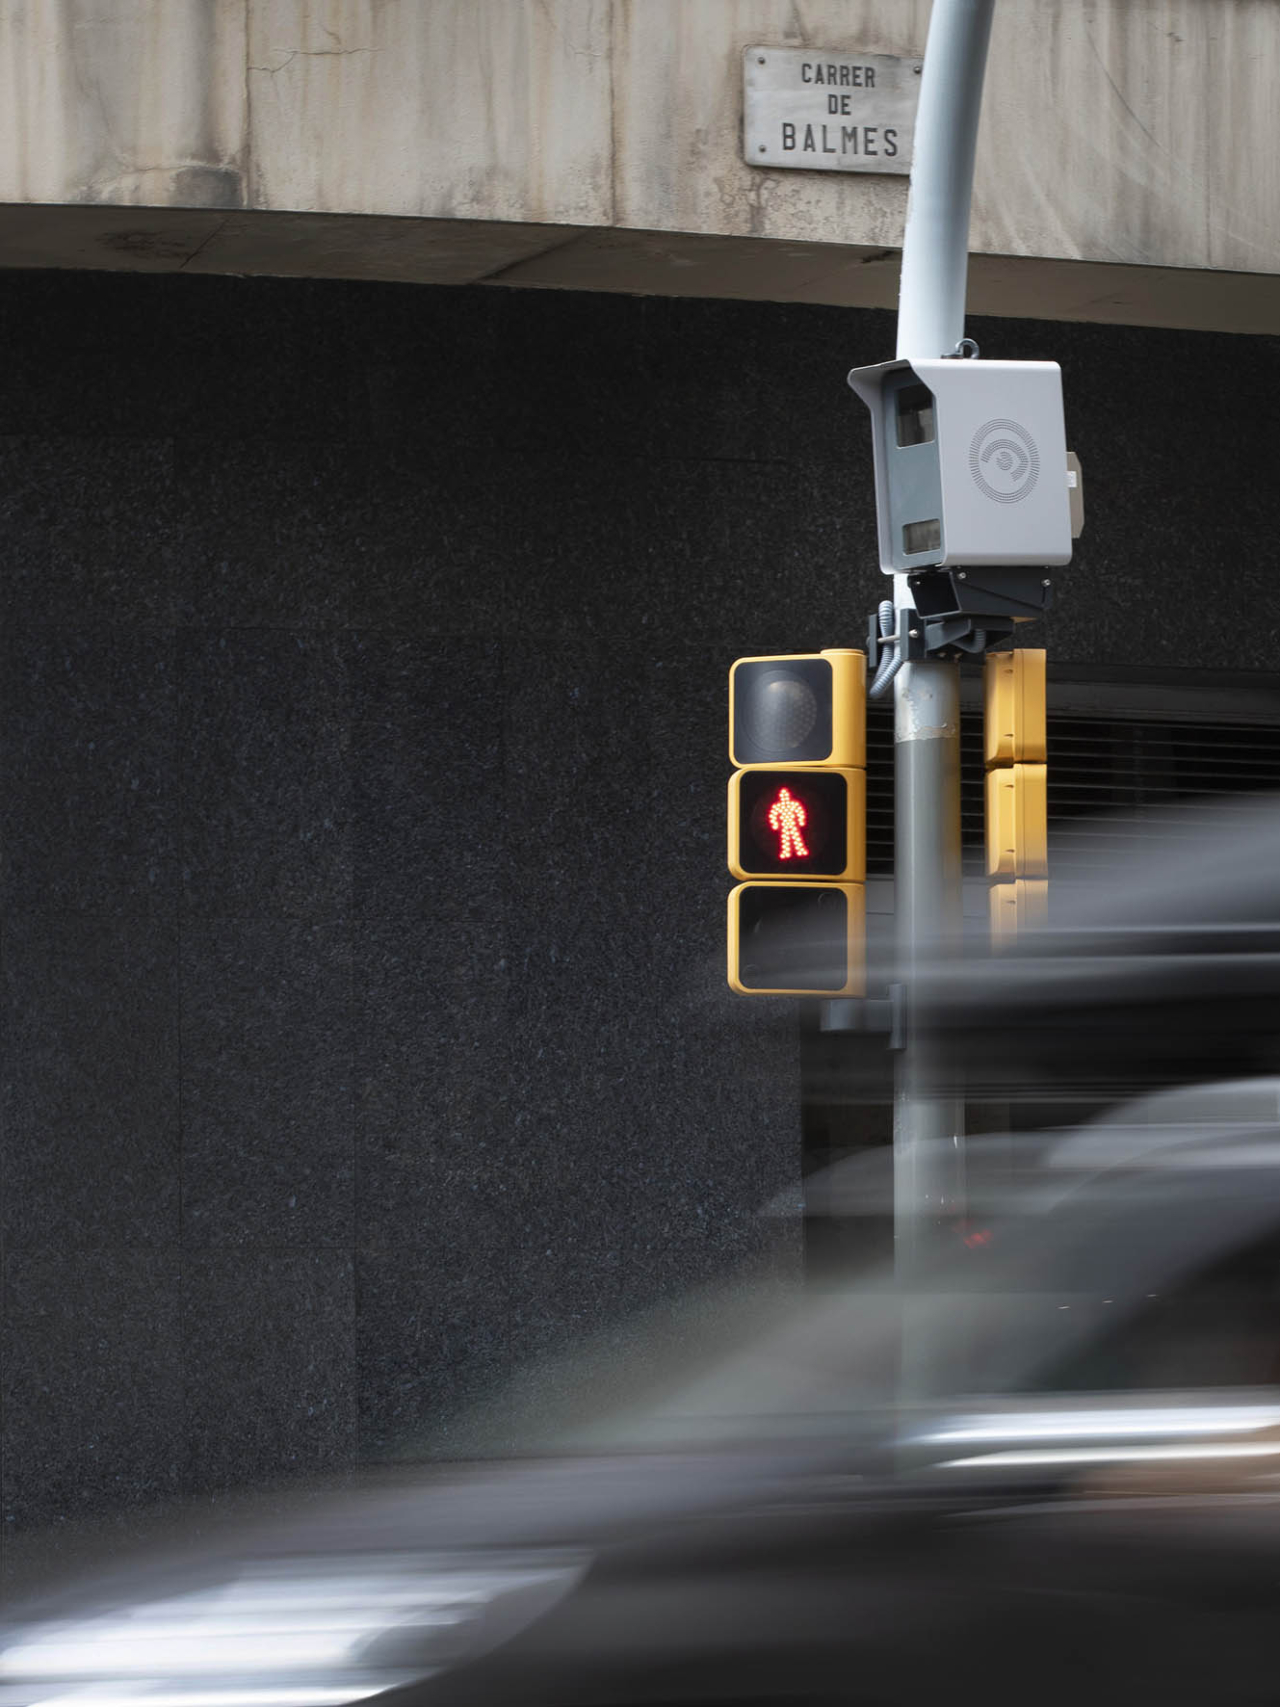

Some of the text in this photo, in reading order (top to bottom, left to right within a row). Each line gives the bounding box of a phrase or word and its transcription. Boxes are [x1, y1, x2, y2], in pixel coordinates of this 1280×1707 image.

[802, 63, 875, 88] CARRER
[828, 94, 852, 116] DE
[783, 123, 898, 157] BALMES
